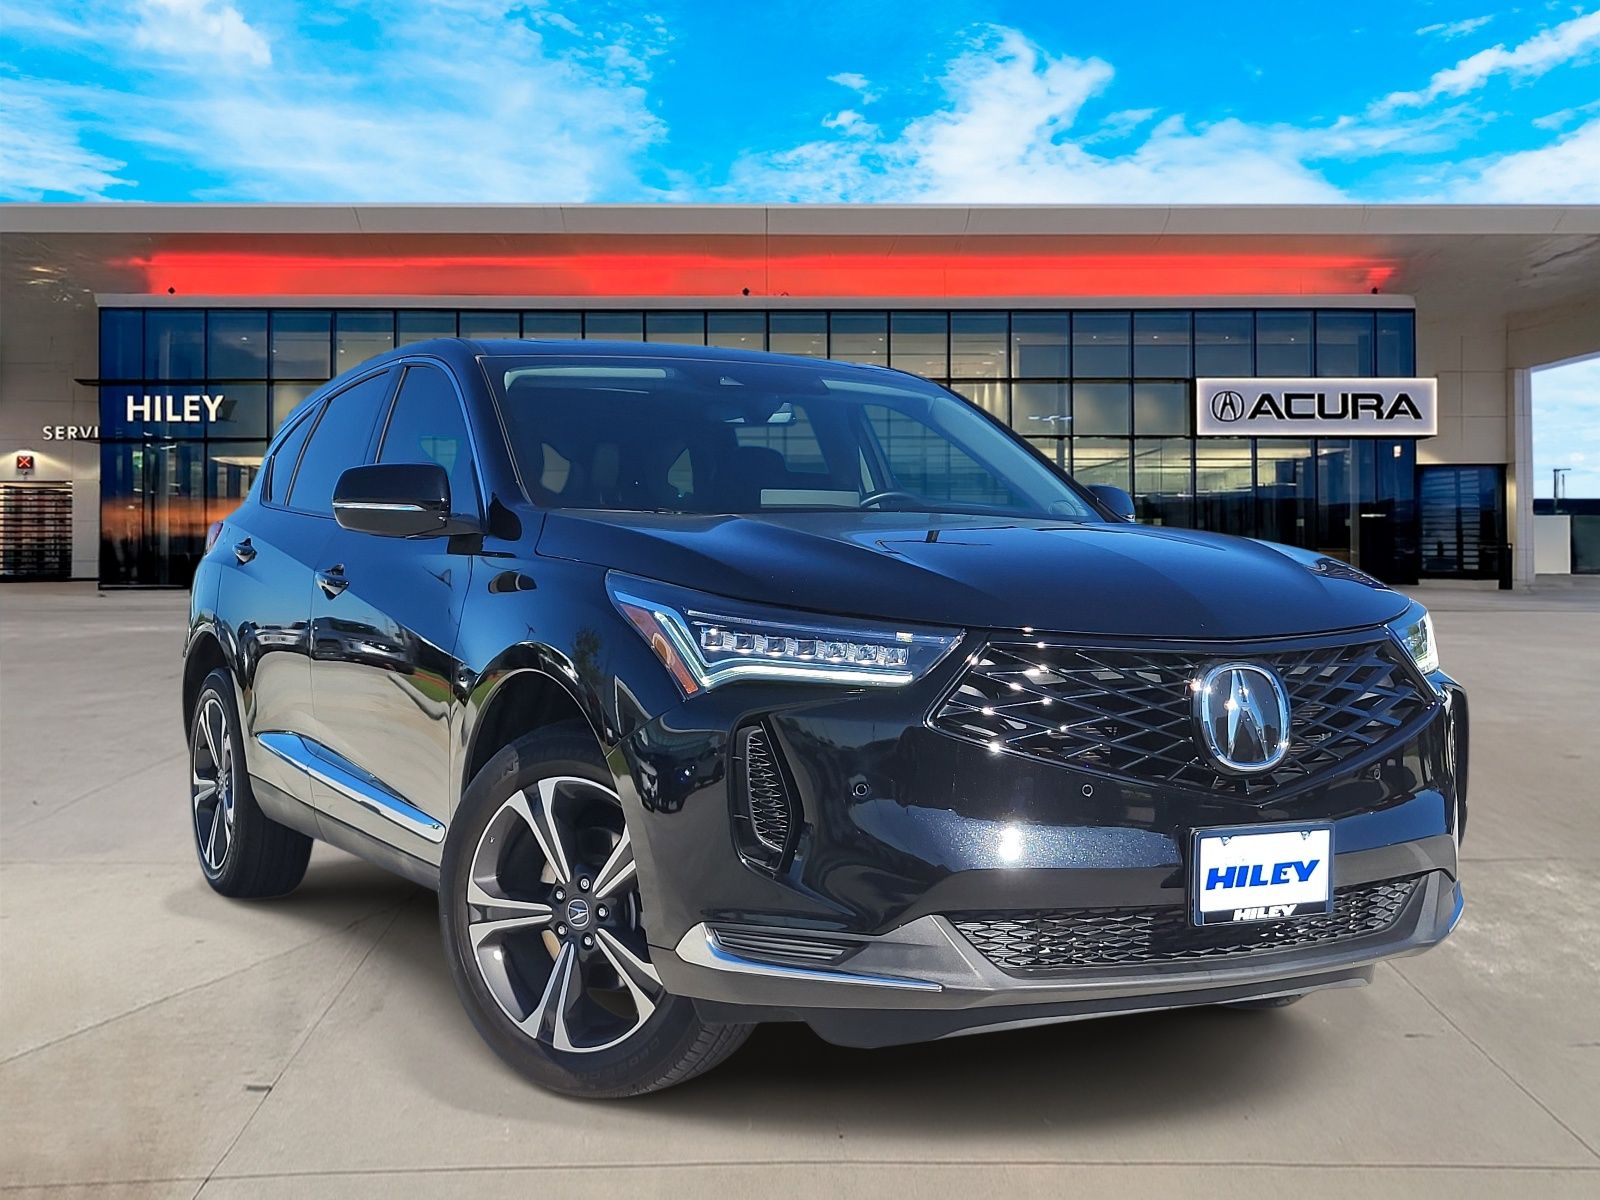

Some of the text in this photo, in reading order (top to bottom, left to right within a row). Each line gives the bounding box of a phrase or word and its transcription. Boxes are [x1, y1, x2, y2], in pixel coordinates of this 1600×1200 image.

[126, 395, 224, 422] HILEY
[1247, 393, 1423, 419] ACURA
[1205, 859, 1320, 890] HILEY
[1232, 904, 1297, 921] HILEY
